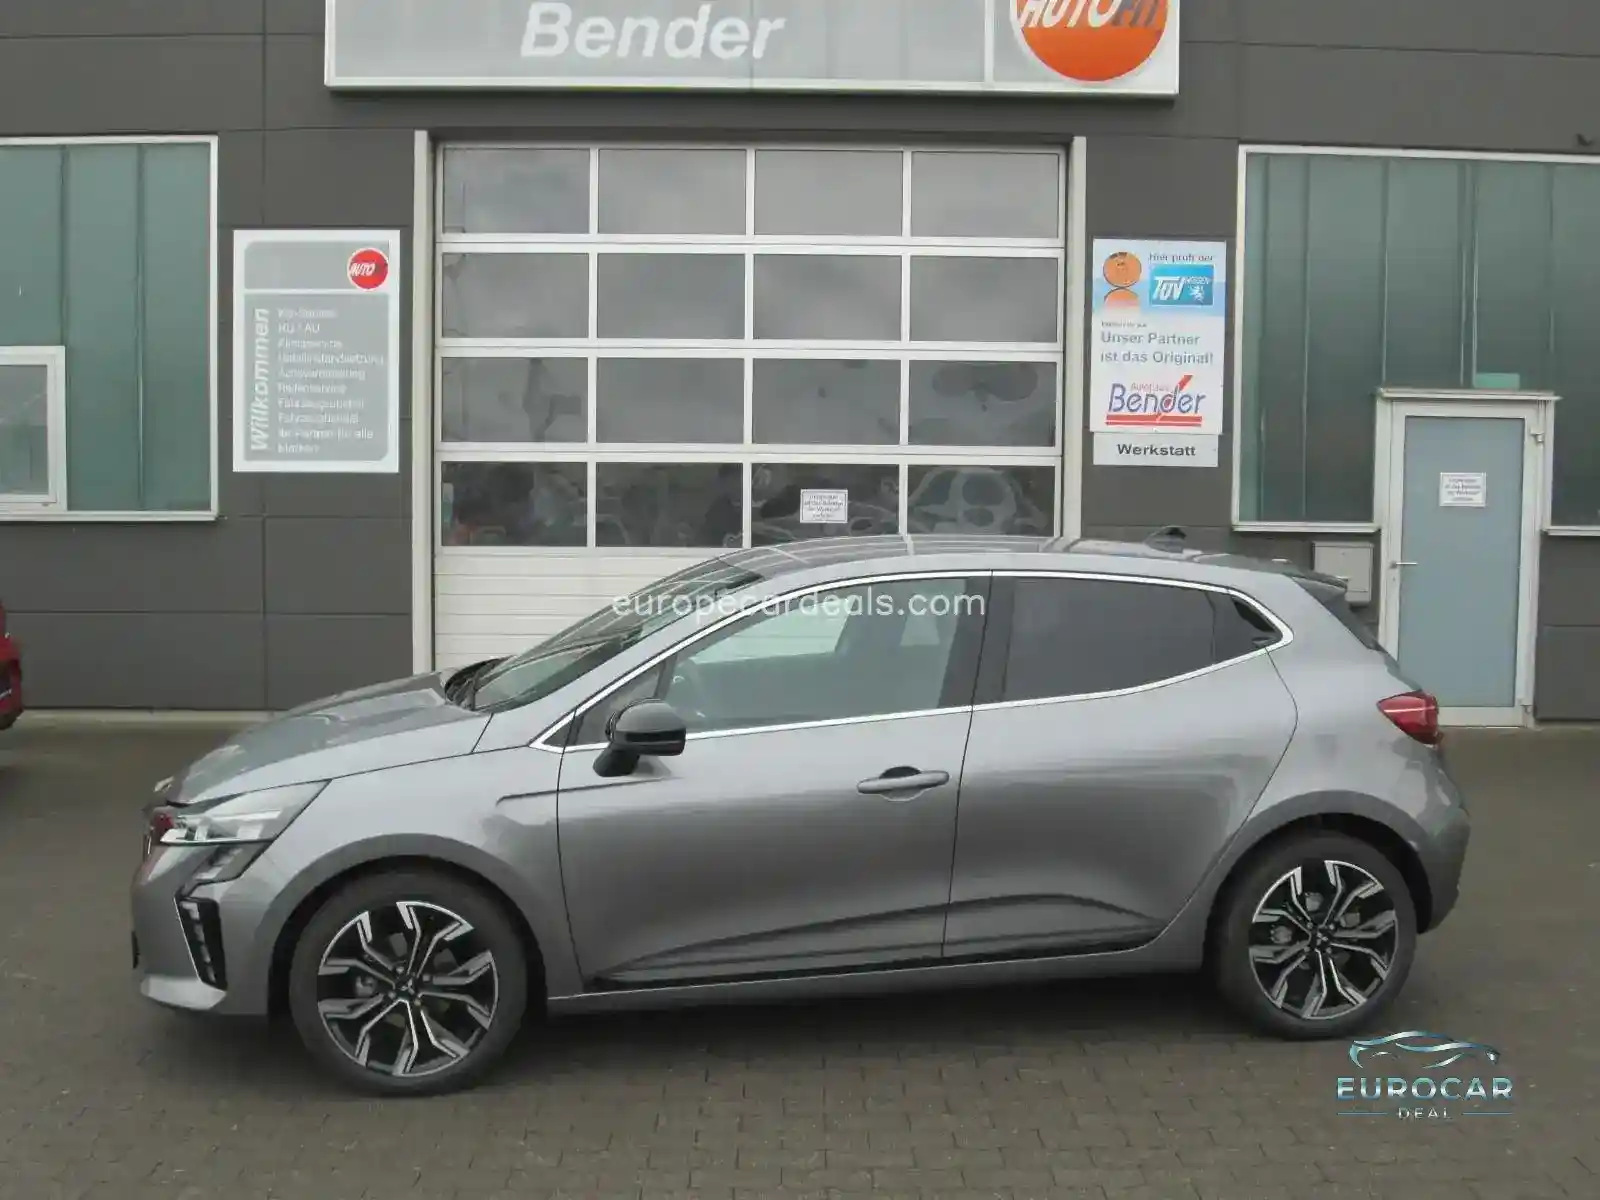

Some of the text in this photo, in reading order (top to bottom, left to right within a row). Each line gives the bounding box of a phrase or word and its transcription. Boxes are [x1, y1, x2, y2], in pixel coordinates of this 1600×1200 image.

[521, 1, 788, 60] Bender
[304, 321, 320, 334] AU
[1101, 331, 1201, 345] Unser Partner
[1100, 350, 1214, 366] ist das Original!
[251, 307, 270, 451] Willkommen
[1108, 382, 1207, 415] Bender
[1117, 443, 1197, 457] Werkstatt
